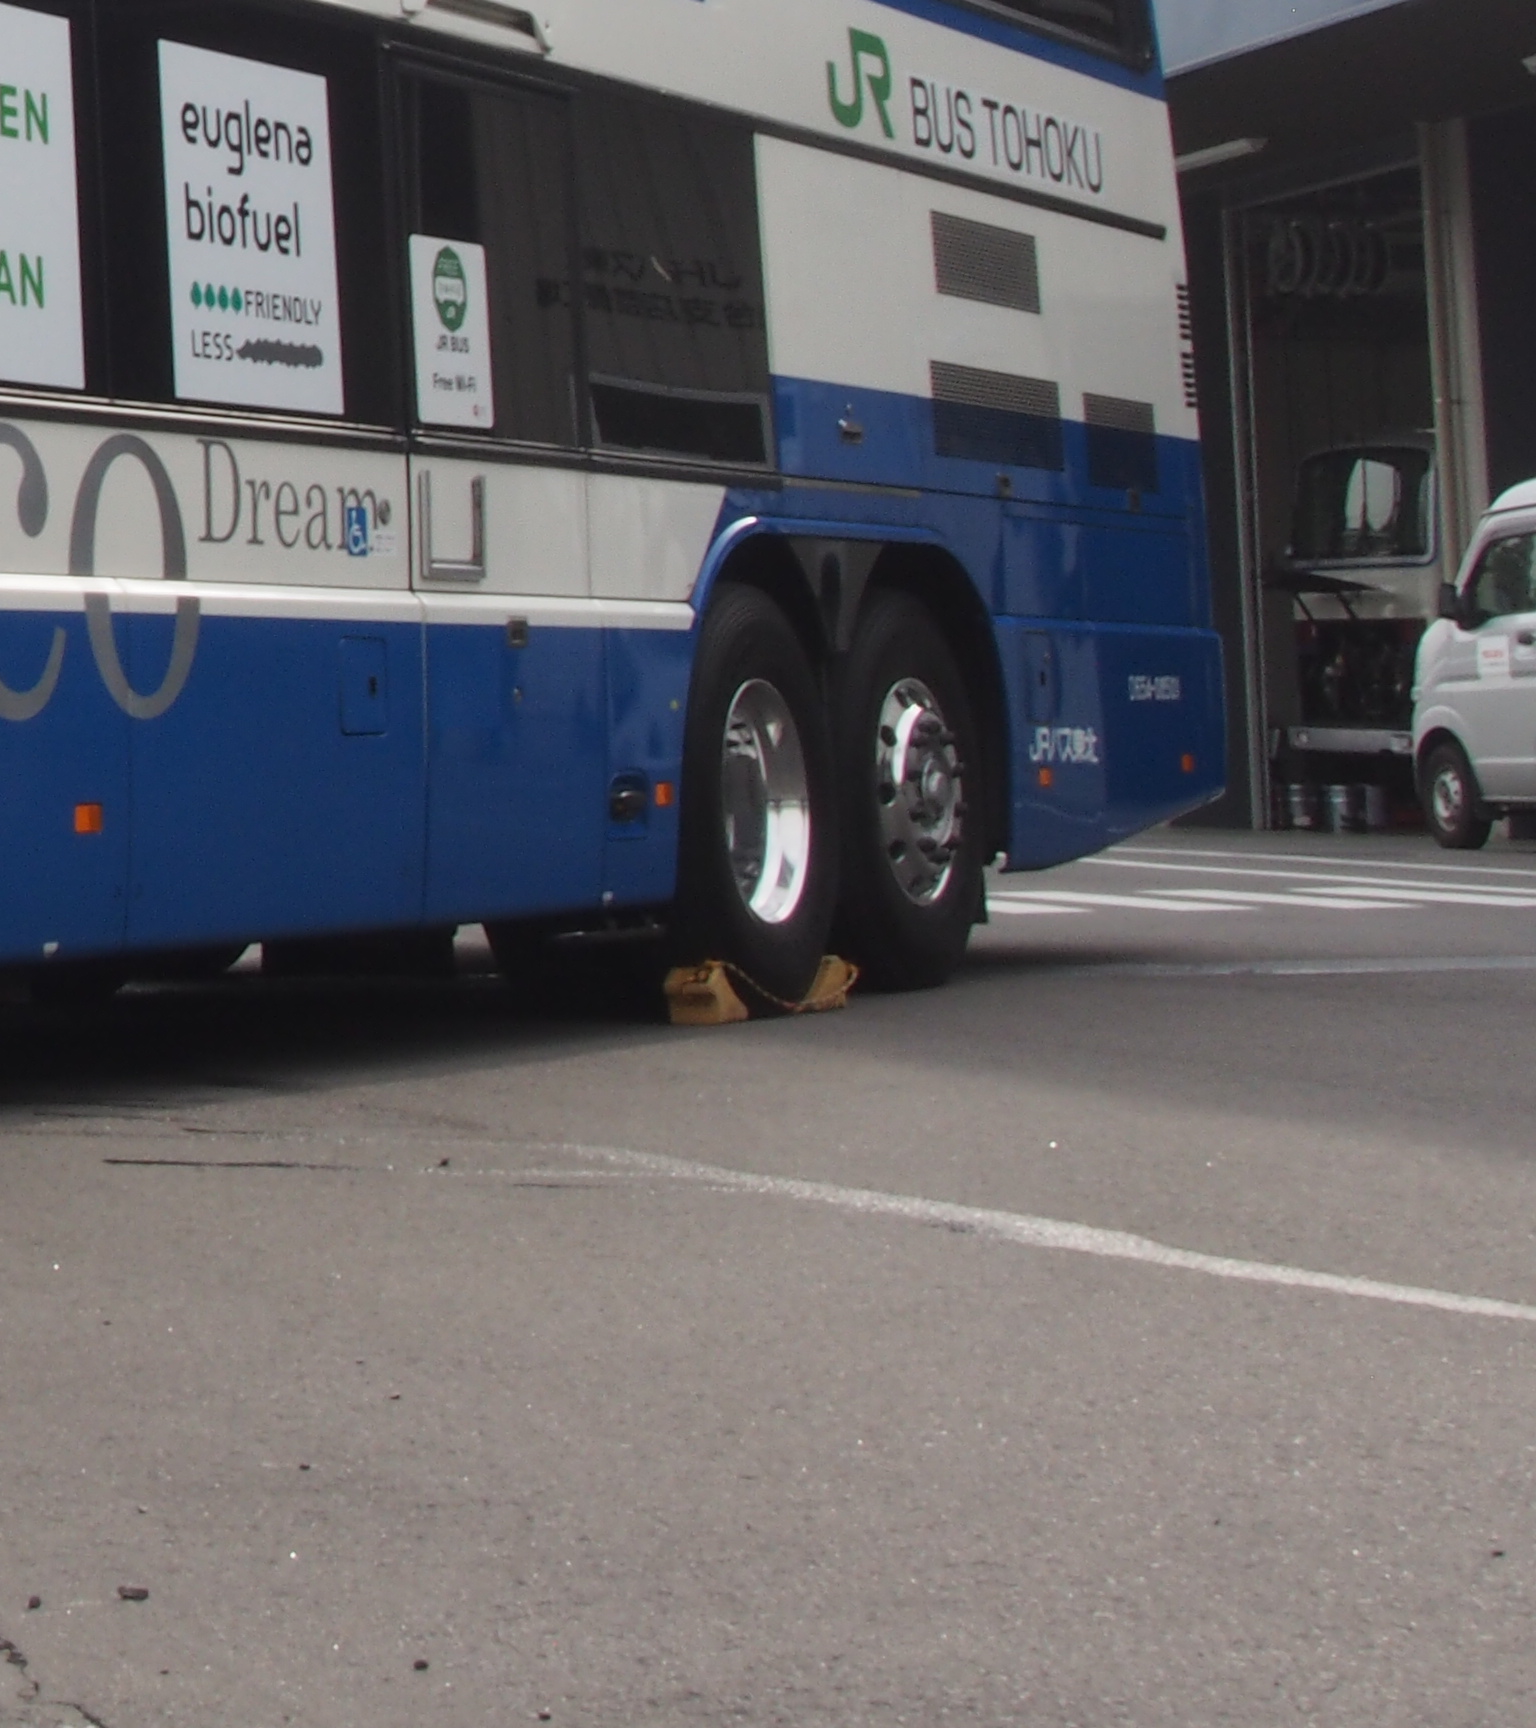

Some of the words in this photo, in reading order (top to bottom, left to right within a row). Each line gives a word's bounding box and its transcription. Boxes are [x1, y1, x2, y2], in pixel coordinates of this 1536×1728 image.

[180, 99, 314, 176] euglena
[826, 27, 895, 139] JR
[910, 76, 976, 160] BUS
[982, 101, 1104, 195] TOHOKU
[185, 182, 302, 257] biofuel
[191, 329, 235, 362] LESS
[244, 288, 323, 327] FRIENDLY
[196, 438, 380, 551] Dream
